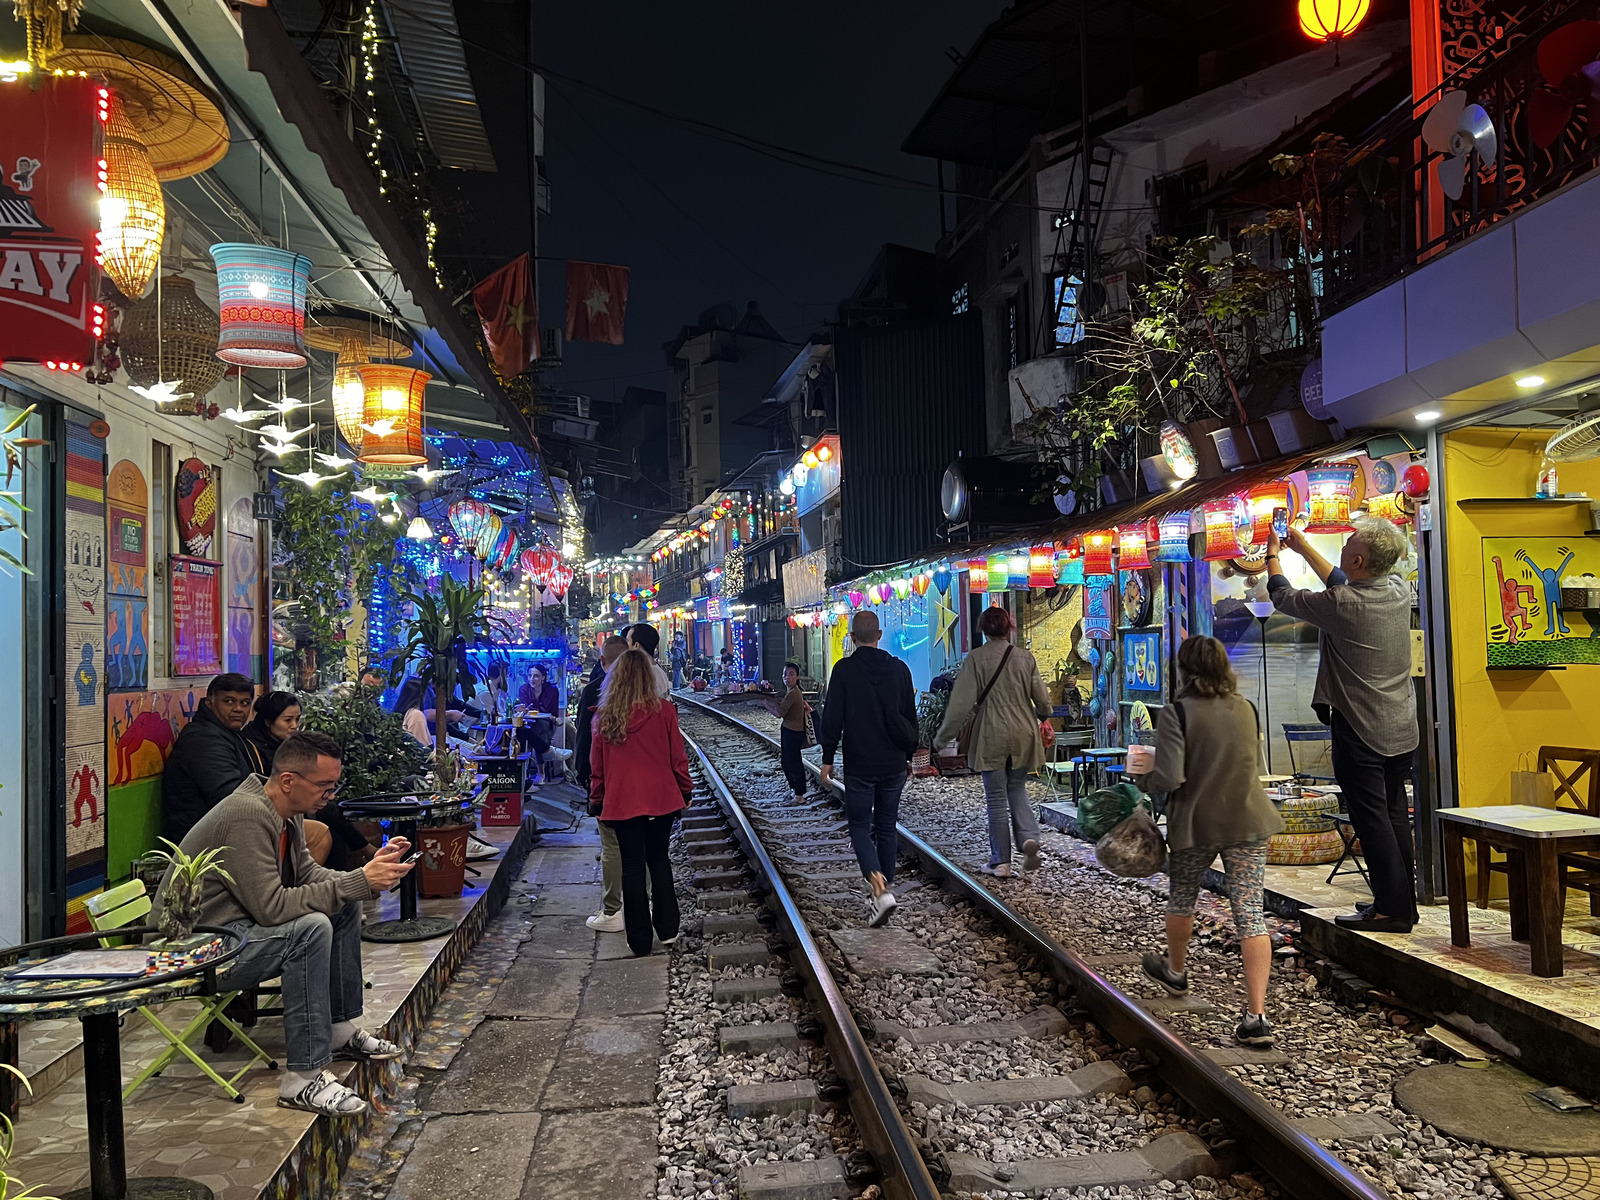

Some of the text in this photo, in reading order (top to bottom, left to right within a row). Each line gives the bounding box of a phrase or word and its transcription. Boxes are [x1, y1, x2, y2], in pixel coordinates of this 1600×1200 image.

[0, 250, 82, 304] AY
[1304, 383, 1323, 402] BEE
[257, 497, 274, 515] 110
[127, 525, 136, 536] NO
[1410, 581, 1417, 592] N
